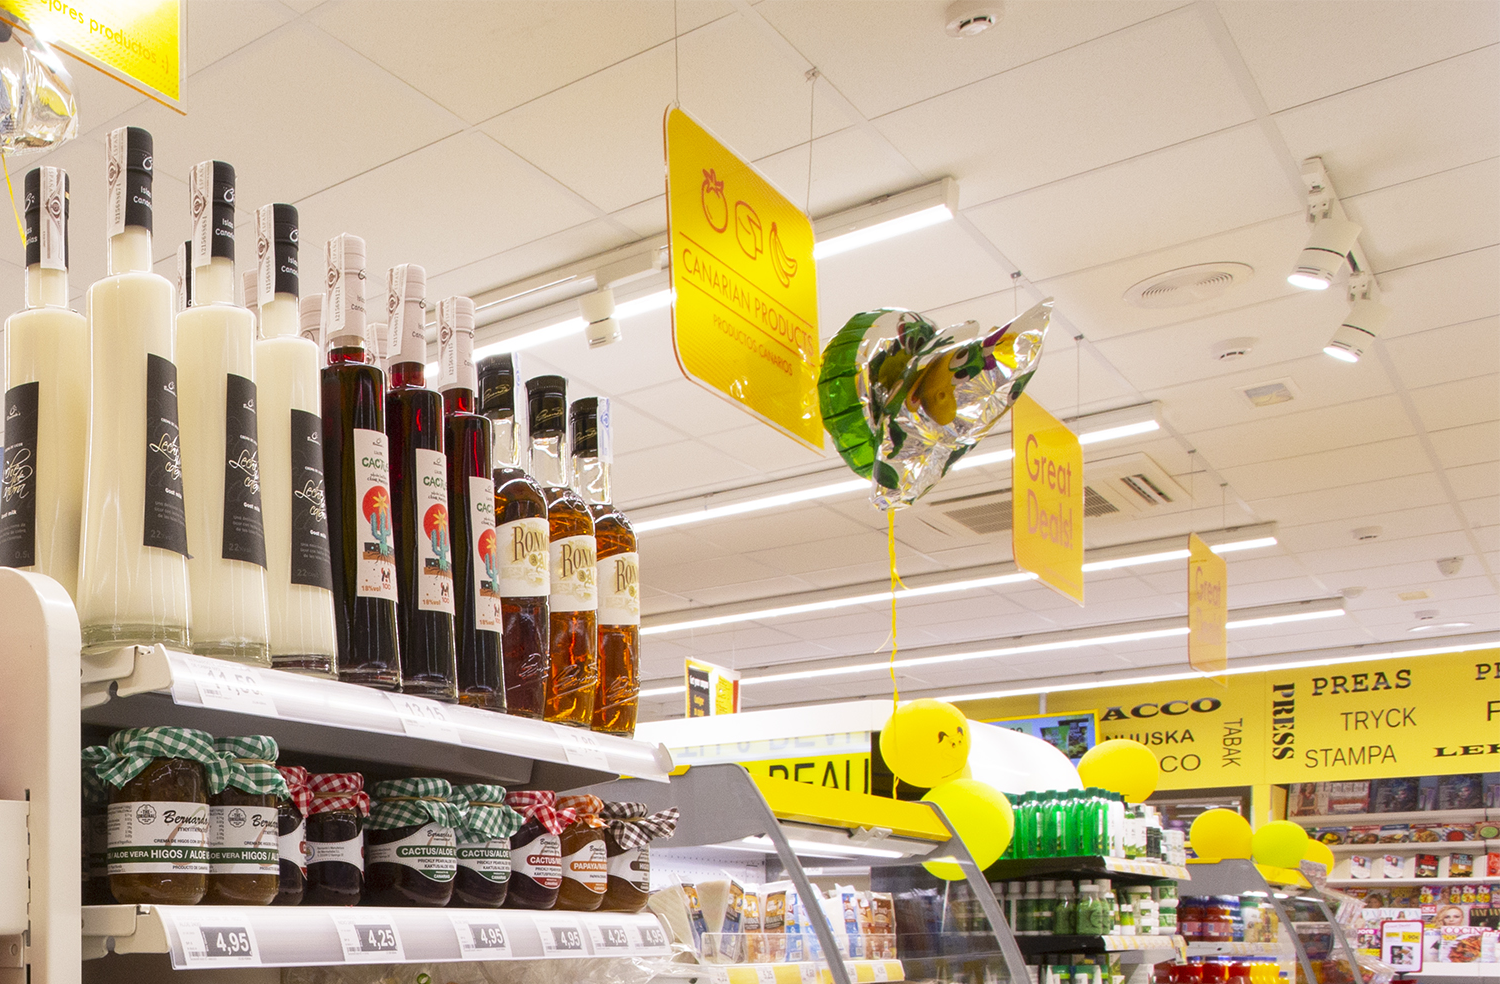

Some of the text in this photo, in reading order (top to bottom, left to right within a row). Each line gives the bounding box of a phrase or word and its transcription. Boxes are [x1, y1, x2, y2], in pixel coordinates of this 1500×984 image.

[90, 18, 157, 64] productos
[683, 248, 814, 357] CANARIAN PRODUCTS
[713, 314, 793, 376] PRODUCTOS CANARIOS
[1025, 433, 1072, 497] Great
[1027, 488, 1073, 550] Deals!
[1312, 669, 1412, 696] PREAS
[1272, 683, 1295, 760] PRESS
[1341, 707, 1417, 731] TRYCK
[1222, 718, 1243, 768] TABAK
[1305, 745, 1396, 768] STAMPA
[151, 850, 183, 859] HIGOS
[242, 852, 267, 860] HIGOS
[401, 847, 453, 856] CACTUS/ALOE
[462, 850, 509, 858] CACTUS/ALOE
